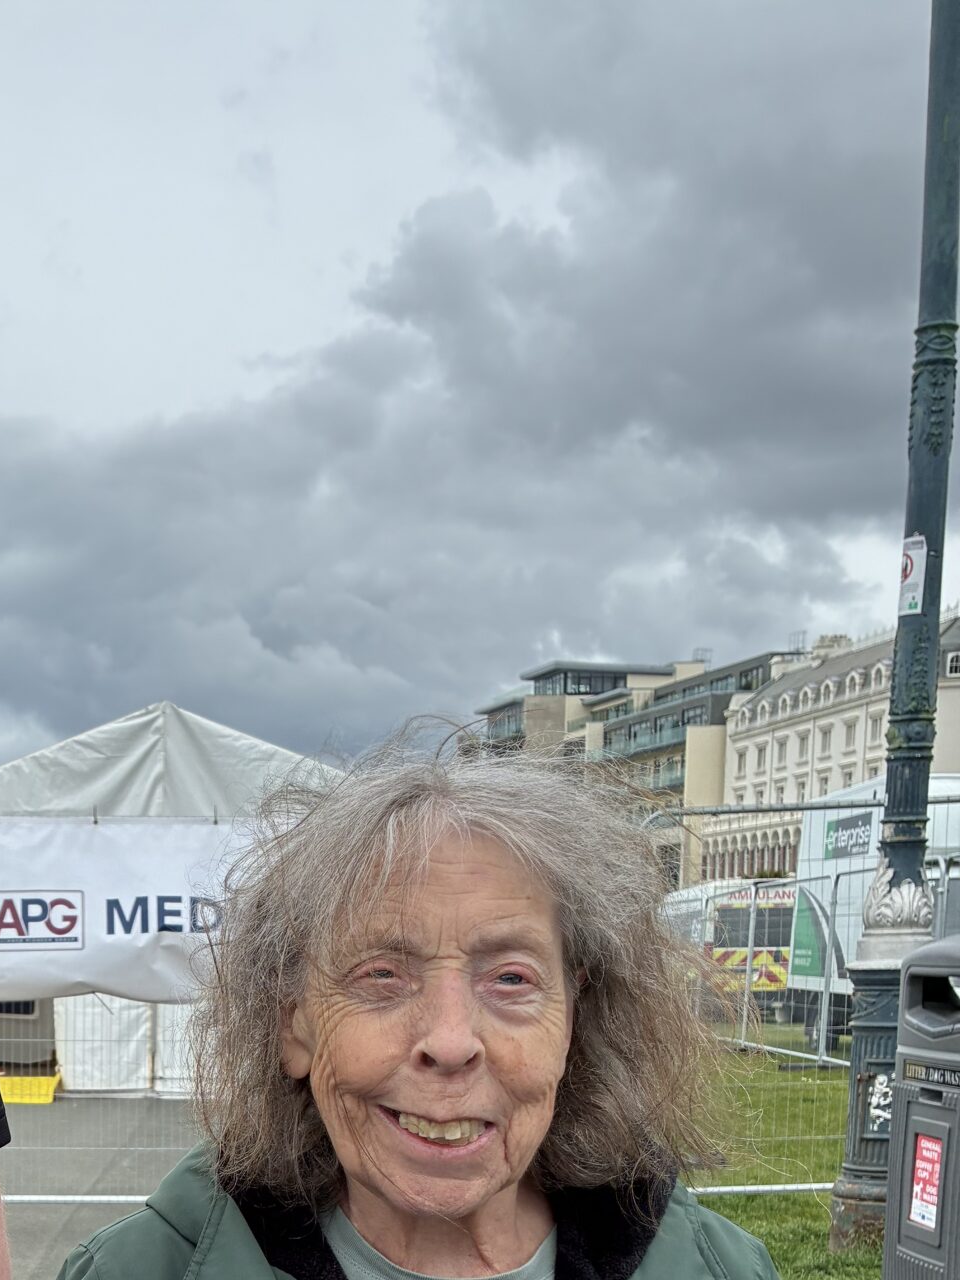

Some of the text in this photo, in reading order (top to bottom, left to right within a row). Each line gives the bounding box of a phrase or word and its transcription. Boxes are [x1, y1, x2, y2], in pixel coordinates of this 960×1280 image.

[825, 820, 870, 852] enterprise
[729, 888, 797, 900] AMULAN
[106, 895, 225, 935] MED
